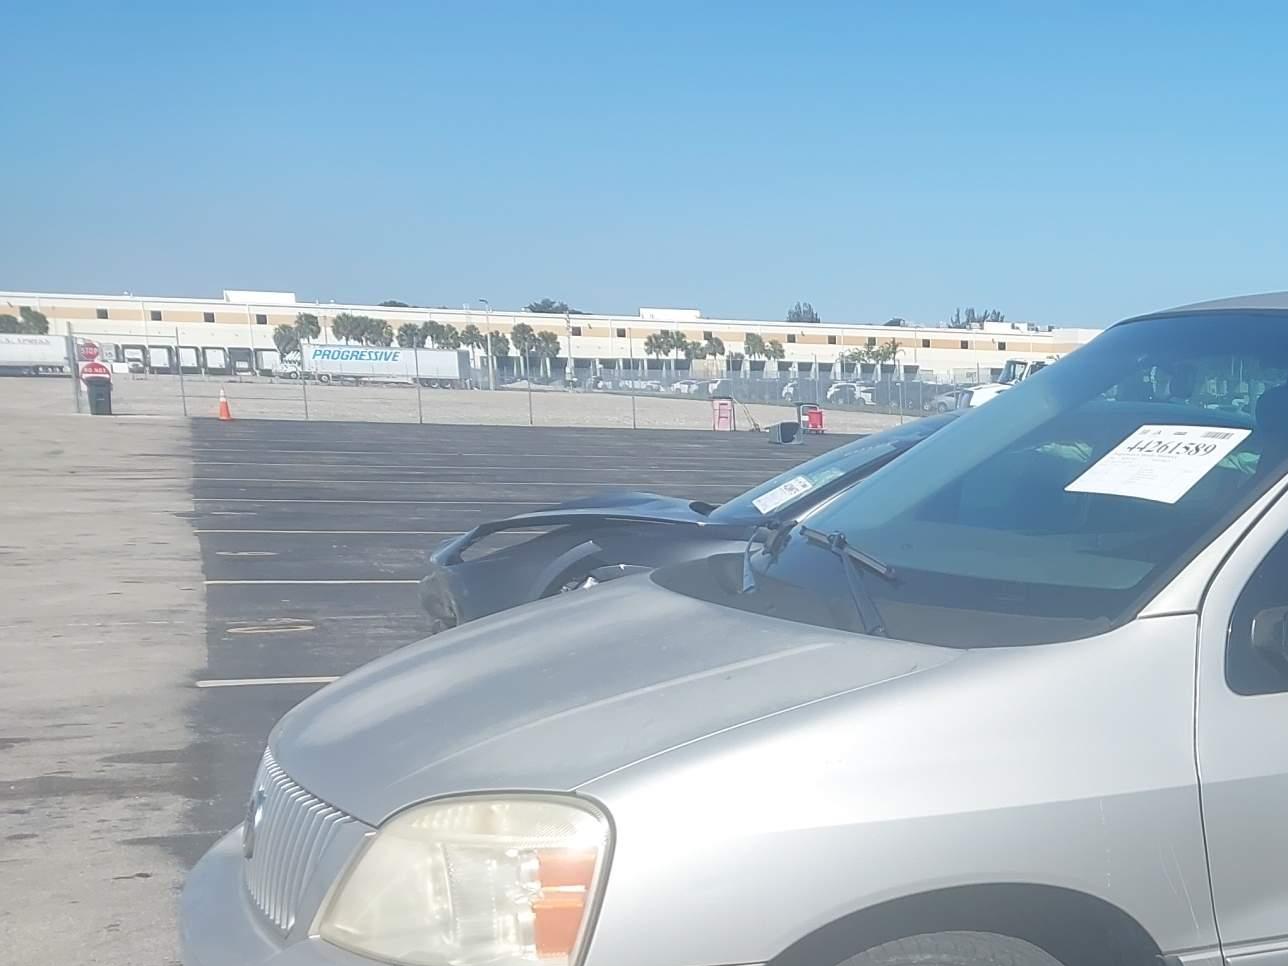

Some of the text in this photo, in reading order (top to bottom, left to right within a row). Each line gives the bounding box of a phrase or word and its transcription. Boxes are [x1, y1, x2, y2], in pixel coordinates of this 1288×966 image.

[80, 347, 97, 355] STOP
[312, 350, 400, 362] PROGRESSIVE
[1127, 440, 1217, 457] 44261589
